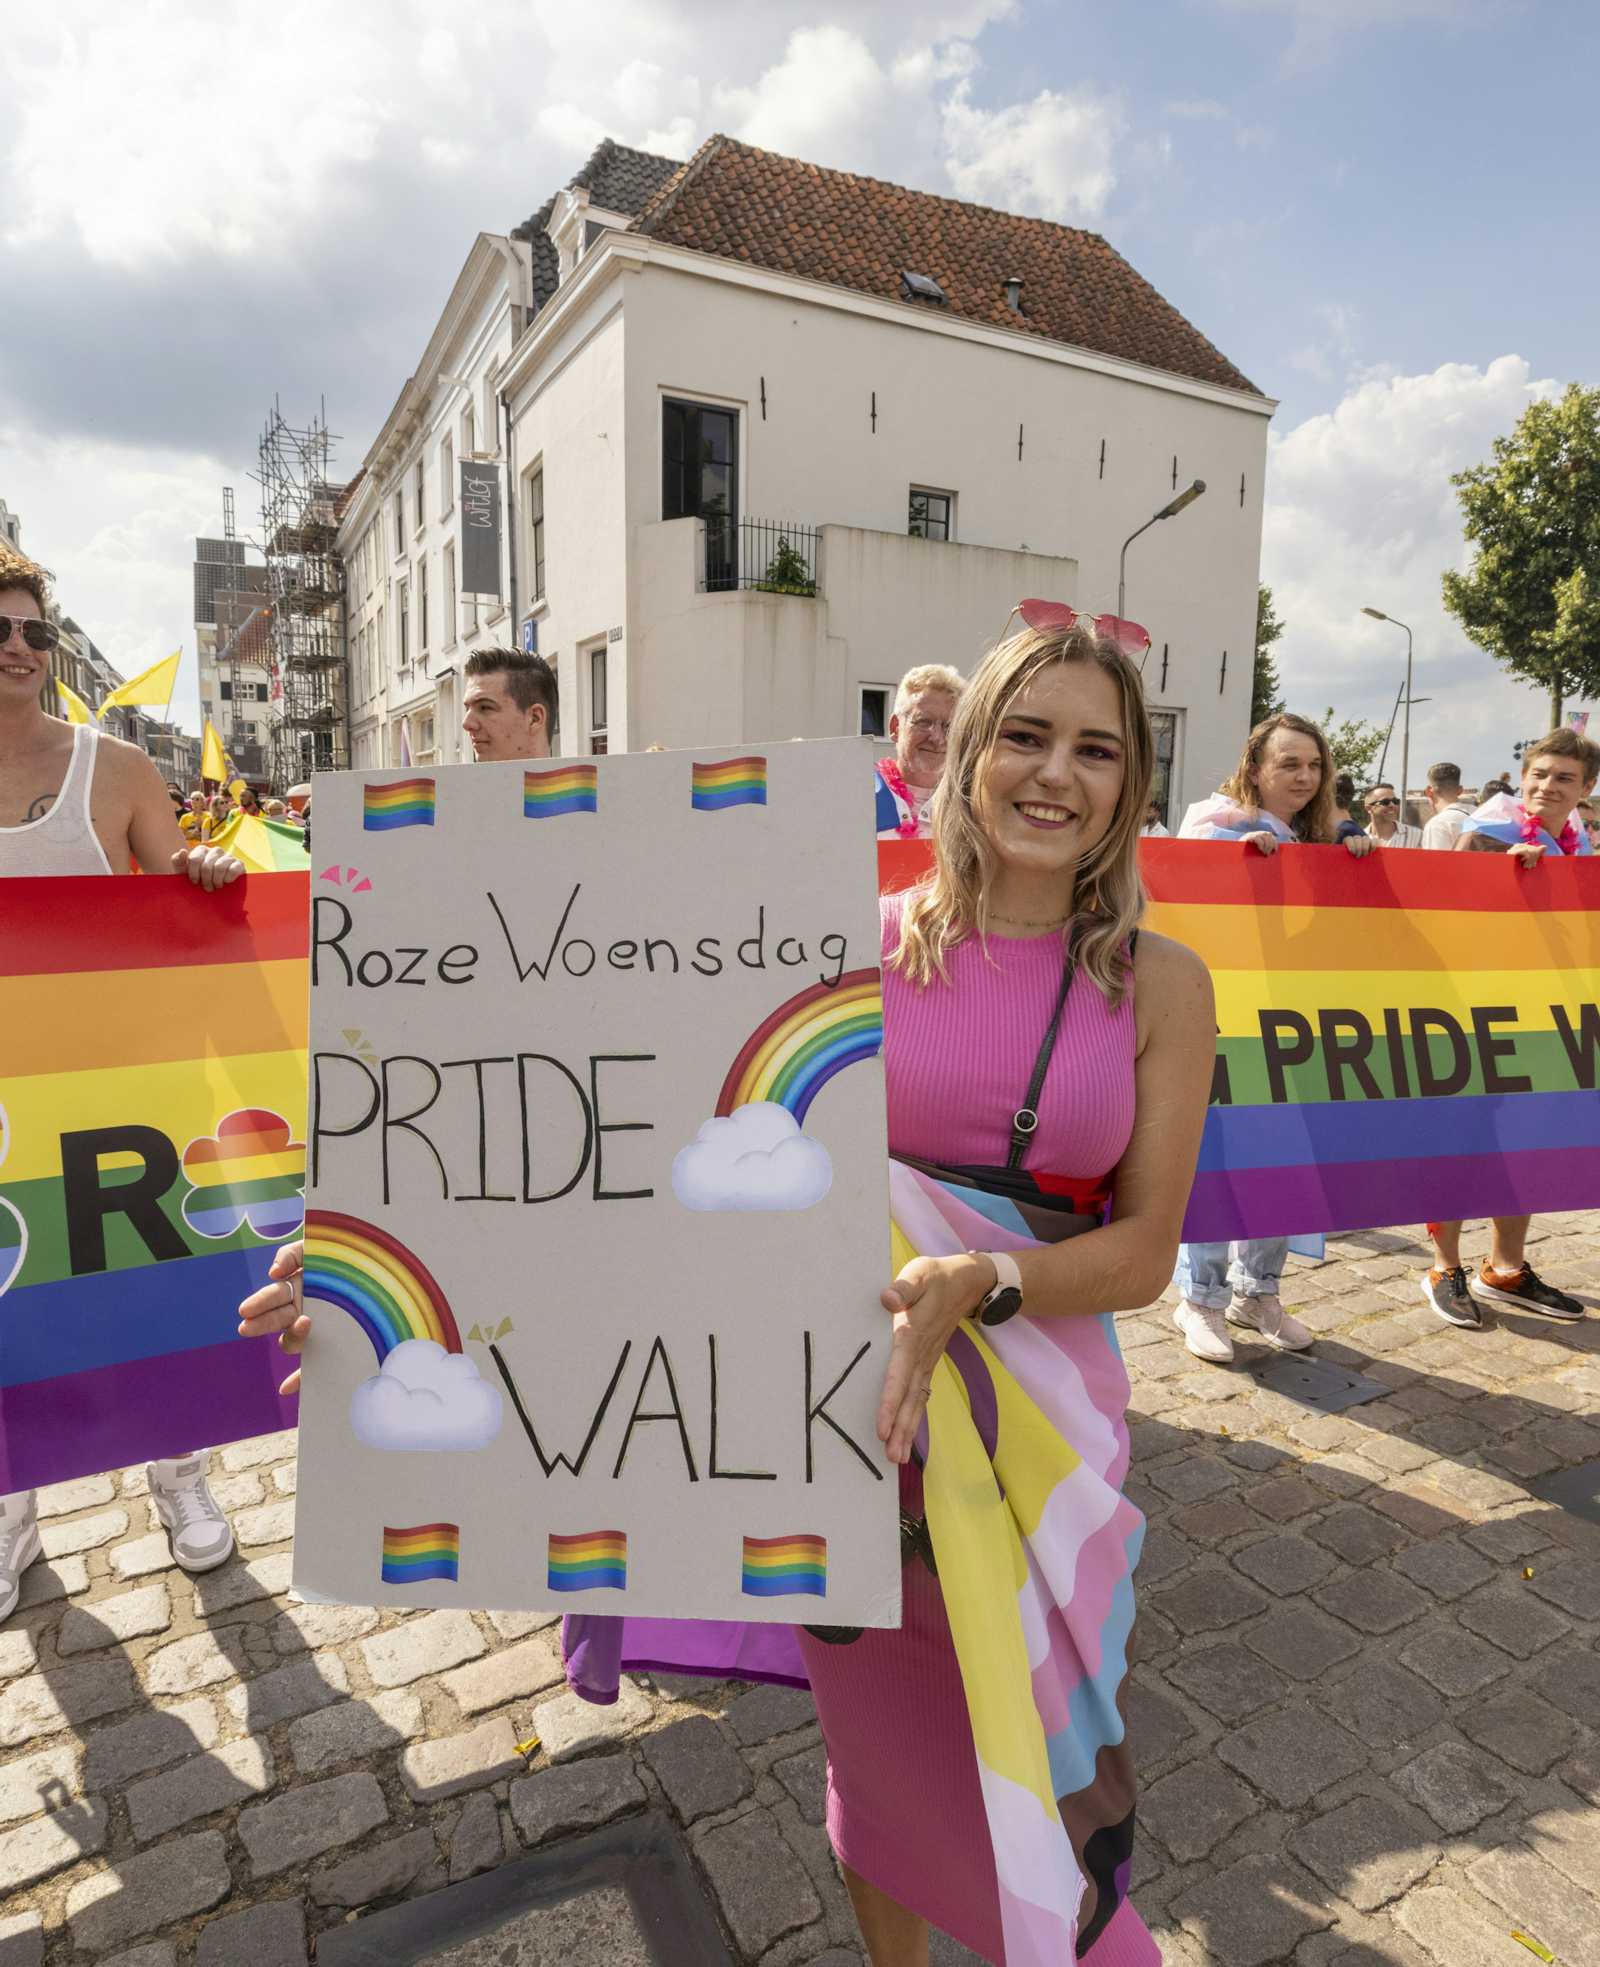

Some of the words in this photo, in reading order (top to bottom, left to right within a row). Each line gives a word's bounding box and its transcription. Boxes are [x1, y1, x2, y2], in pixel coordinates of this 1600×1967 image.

[312, 896, 479, 988] Roze
[487, 883, 847, 989] Woensdag
[1258, 1006, 1533, 1104] PRIDE
[312, 1052, 656, 1205] PRIDE
[489, 1331, 884, 1484] WALK
